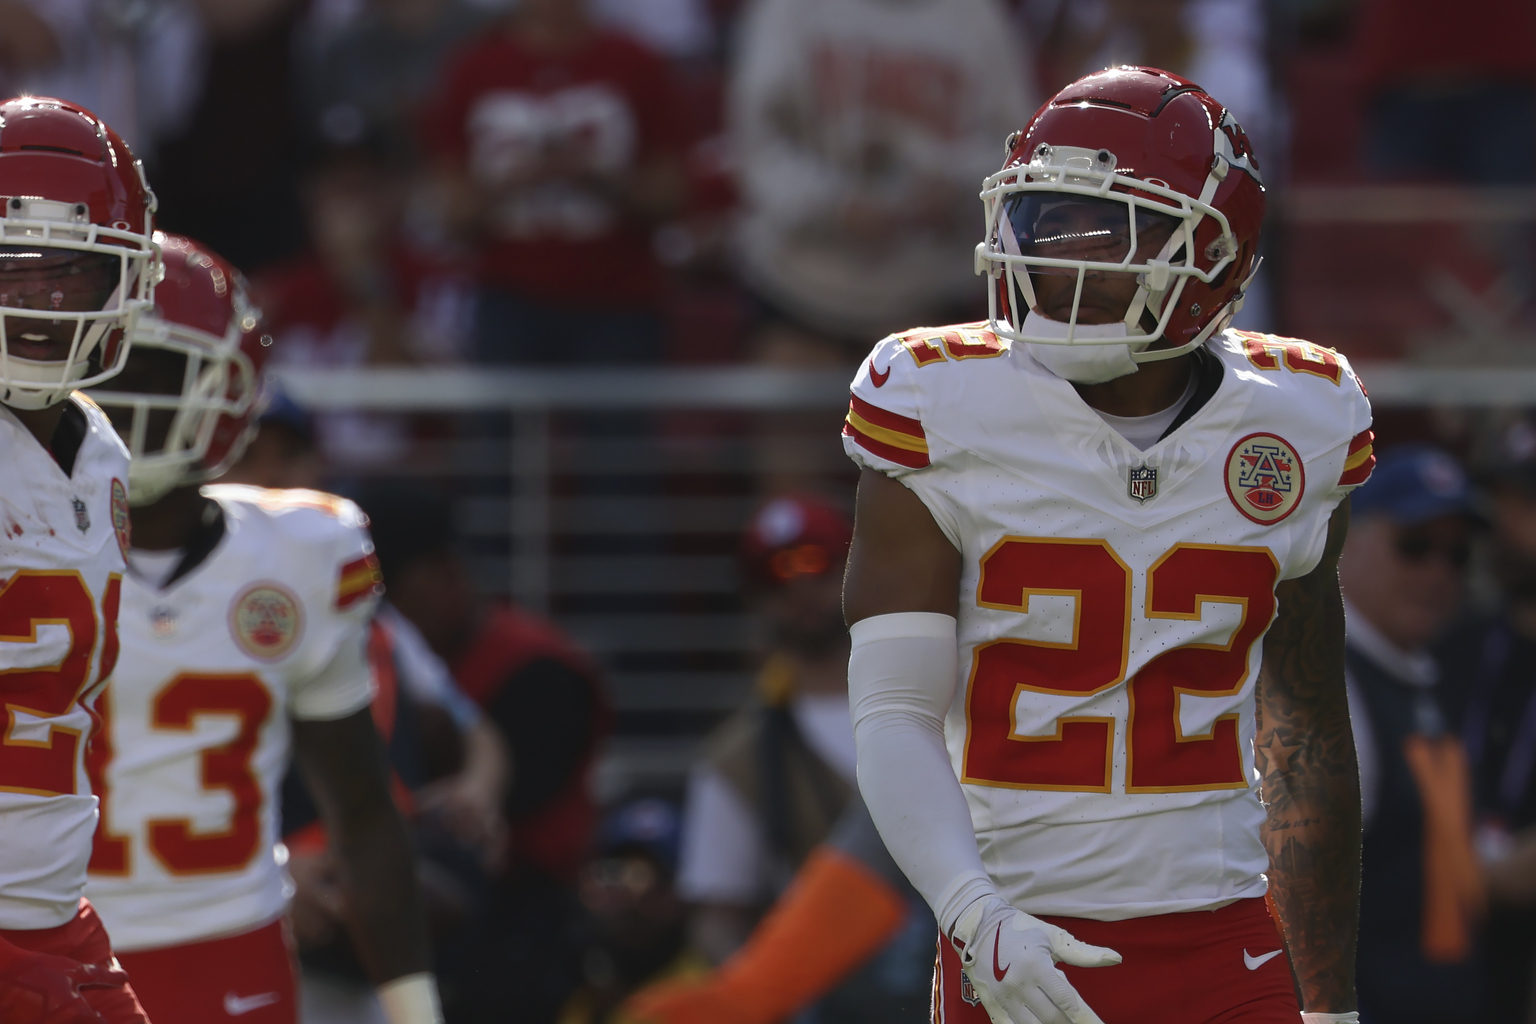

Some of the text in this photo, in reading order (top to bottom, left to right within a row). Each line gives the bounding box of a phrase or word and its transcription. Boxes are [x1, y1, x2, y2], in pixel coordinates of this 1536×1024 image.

[1238, 444, 1292, 492] A
[1132, 480, 1155, 498] NFL
[1257, 492, 1274, 505] LH
[960, 534, 1281, 795] 22
